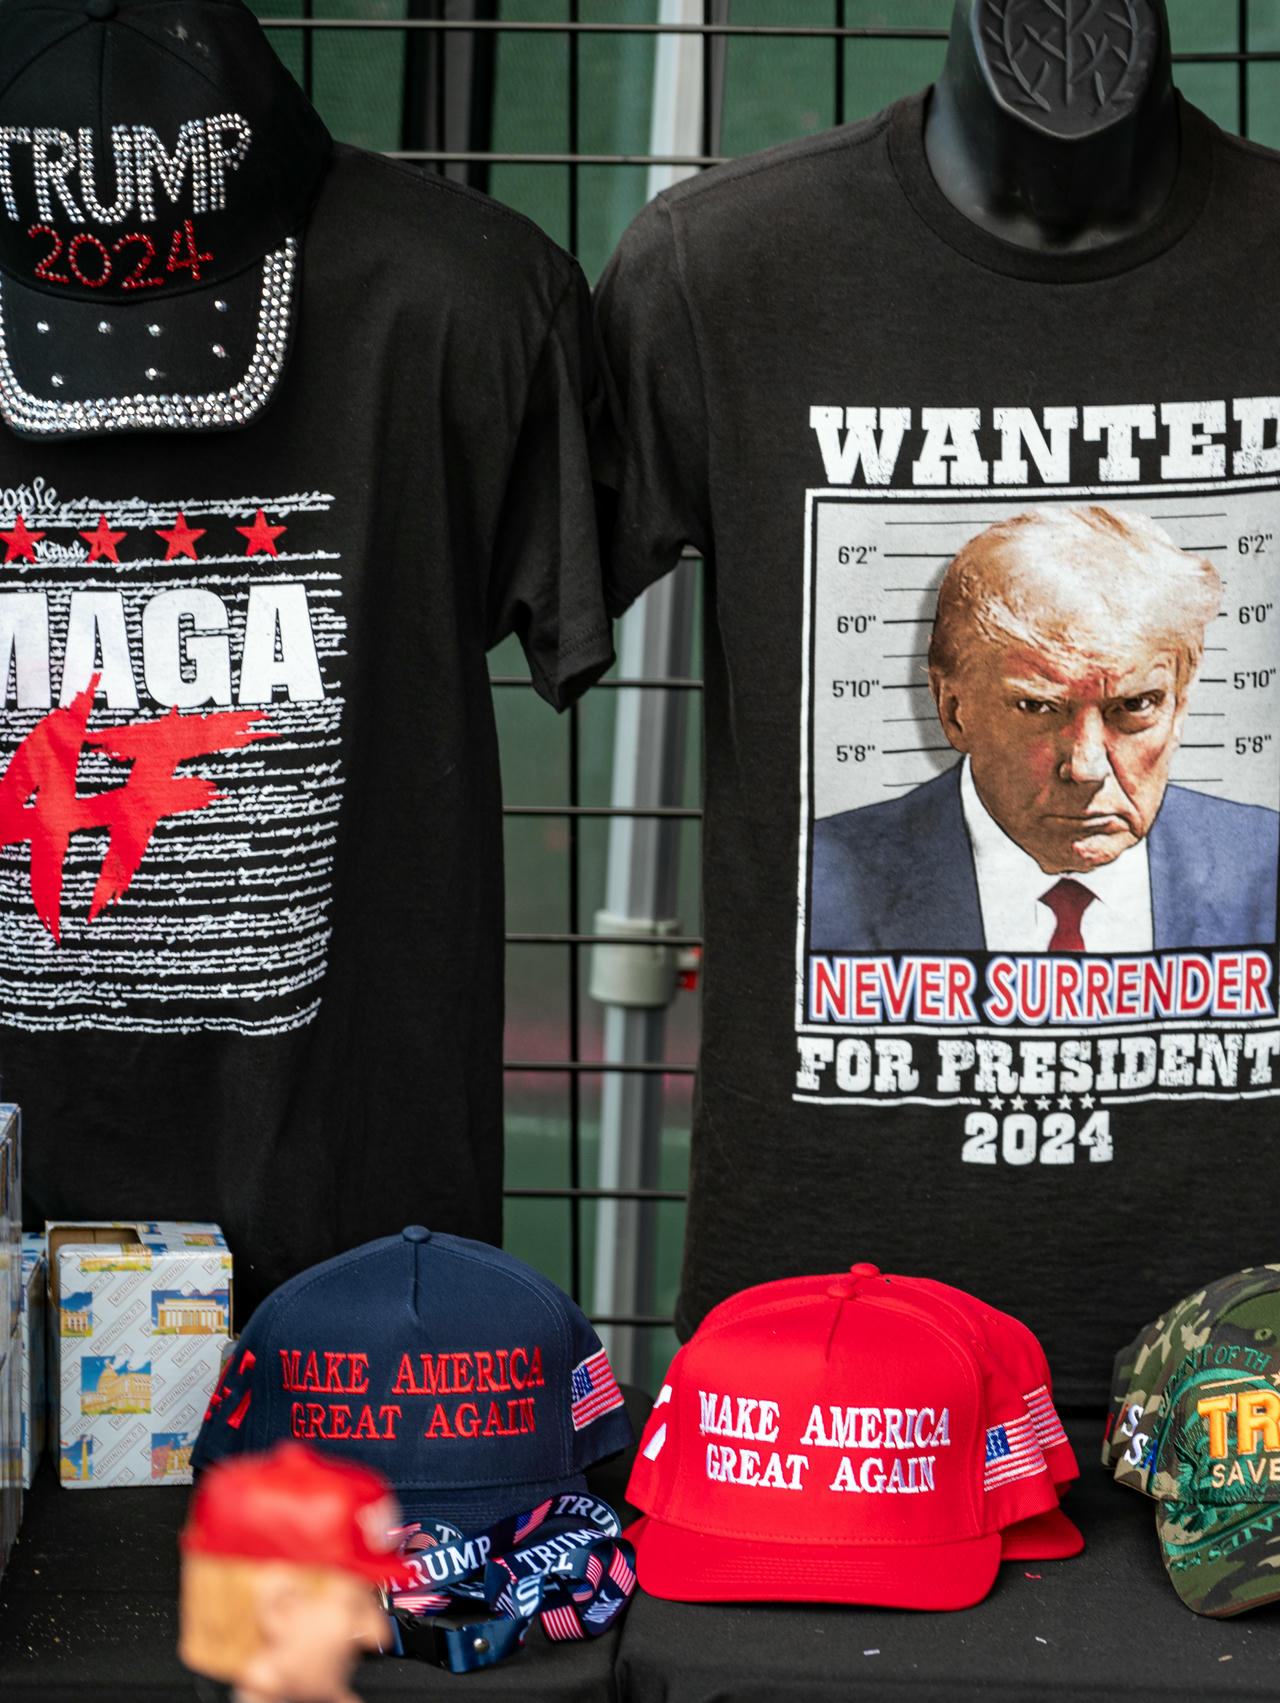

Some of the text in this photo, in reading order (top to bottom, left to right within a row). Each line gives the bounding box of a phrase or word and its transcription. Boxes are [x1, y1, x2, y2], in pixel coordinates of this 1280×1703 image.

[0, 113, 252, 224] TRUMP
[28, 219, 214, 290] 2024
[810, 951, 1275, 1025] NEVER SURRENDER
[796, 1037, 919, 1092] FOR
[961, 1110, 1114, 1165] 2024
[279, 1346, 545, 1396] MAKE AMERICA
[291, 1397, 536, 1440] GREAT AGAIN
[698, 1390, 780, 1441] MAKE
[799, 1404, 951, 1450] AMERICA
[706, 1445, 936, 1494] GREAT AGAIN
